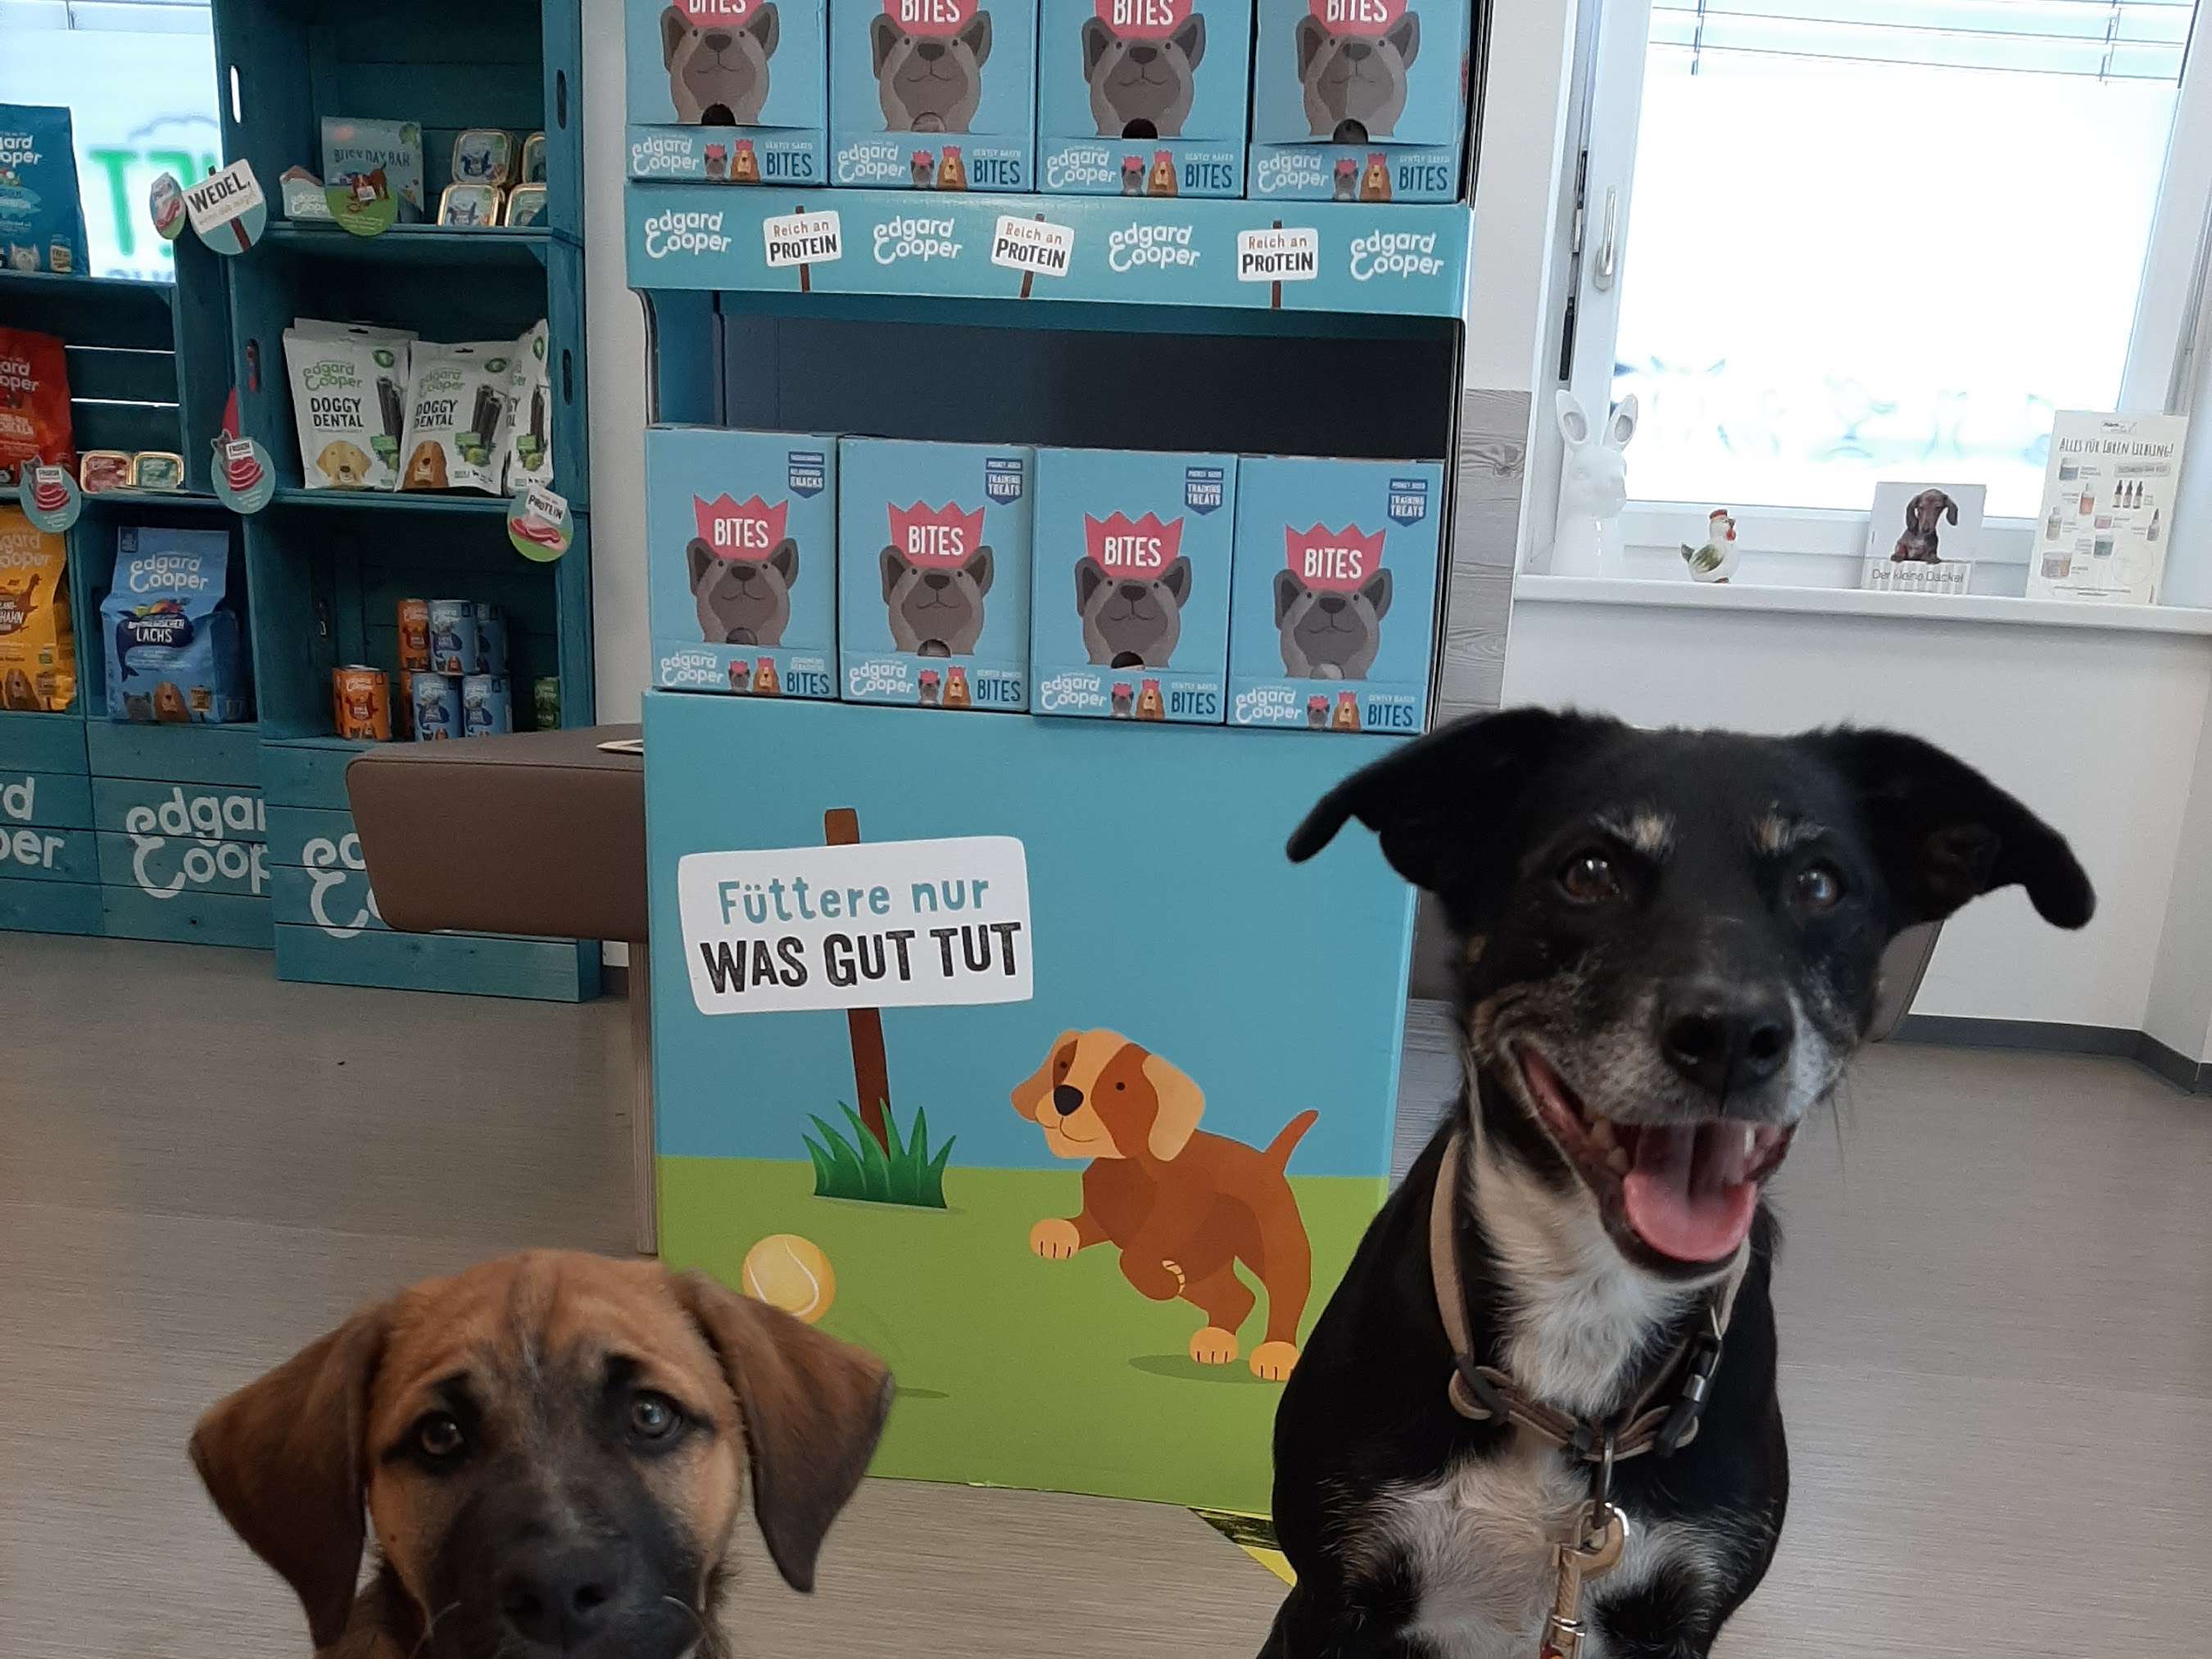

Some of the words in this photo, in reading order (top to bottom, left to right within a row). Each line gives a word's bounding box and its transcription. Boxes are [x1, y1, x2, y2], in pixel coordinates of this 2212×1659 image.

[901, 0, 959, 23] BITES
[1113, 0, 1174, 25] BITES
[1326, 0, 1388, 22] BITES
[632, 138, 692, 161] edgard
[838, 142, 898, 164] edgard
[1047, 147, 1110, 170] edgard
[766, 152, 813, 177] BITES
[973, 159, 1021, 184] BITES
[1258, 152, 1321, 175] edgard
[1185, 164, 1232, 188] BITES
[1398, 165, 1448, 191] BITES
[646, 210, 724, 236] edgard
[773, 223, 808, 238] Reich
[813, 221, 830, 232] an
[873, 215, 954, 241] edgard
[1005, 221, 1041, 242] Reich
[1046, 233, 1063, 245] an
[646, 229, 732, 258] Cooper
[1109, 222, 1192, 248] edgard
[1249, 235, 1285, 249] Reich
[1290, 237, 1308, 248] an
[1350, 229, 1436, 256] edgard
[770, 233, 838, 261] PROTEIN
[873, 235, 963, 265] Cooper
[995, 238, 1066, 269] PROTEIN
[1109, 244, 1201, 272] Cooper
[1242, 252, 1313, 273] PROTEIN
[1350, 251, 1444, 281] Cooper
[303, 361, 355, 377] edgard
[305, 374, 363, 392] Cooper
[310, 397, 361, 413] DOGGY
[415, 399, 459, 417] DOGGY
[313, 413, 365, 427] DENTAL
[414, 413, 454, 428] DENTAL
[988, 483, 1022, 496] TREATS
[1187, 492, 1222, 506] TREATS
[1391, 504, 1425, 518] TREATS
[714, 518, 769, 549] BITES
[908, 525, 964, 555] BITES
[1104, 537, 1162, 568] BITES
[1304, 548, 1363, 578] BITES
[130, 554, 202, 575] edgard
[129, 571, 208, 593] Cooper
[136, 628, 173, 643] LACHS
[661, 654, 717, 674] edgard
[850, 661, 907, 682] edgard
[786, 673, 830, 695] BITES
[977, 679, 1021, 702] BITES
[1041, 674, 1099, 696] edgard
[1172, 691, 1217, 715] BITES
[1235, 687, 1295, 707] edgard
[1367, 704, 1413, 728] BITES
[718, 876, 891, 925] Füttere
[911, 879, 989, 913] nur
[700, 936, 809, 995] WAS
[823, 929, 915, 987] GUT
[930, 922, 1021, 977] TUT
